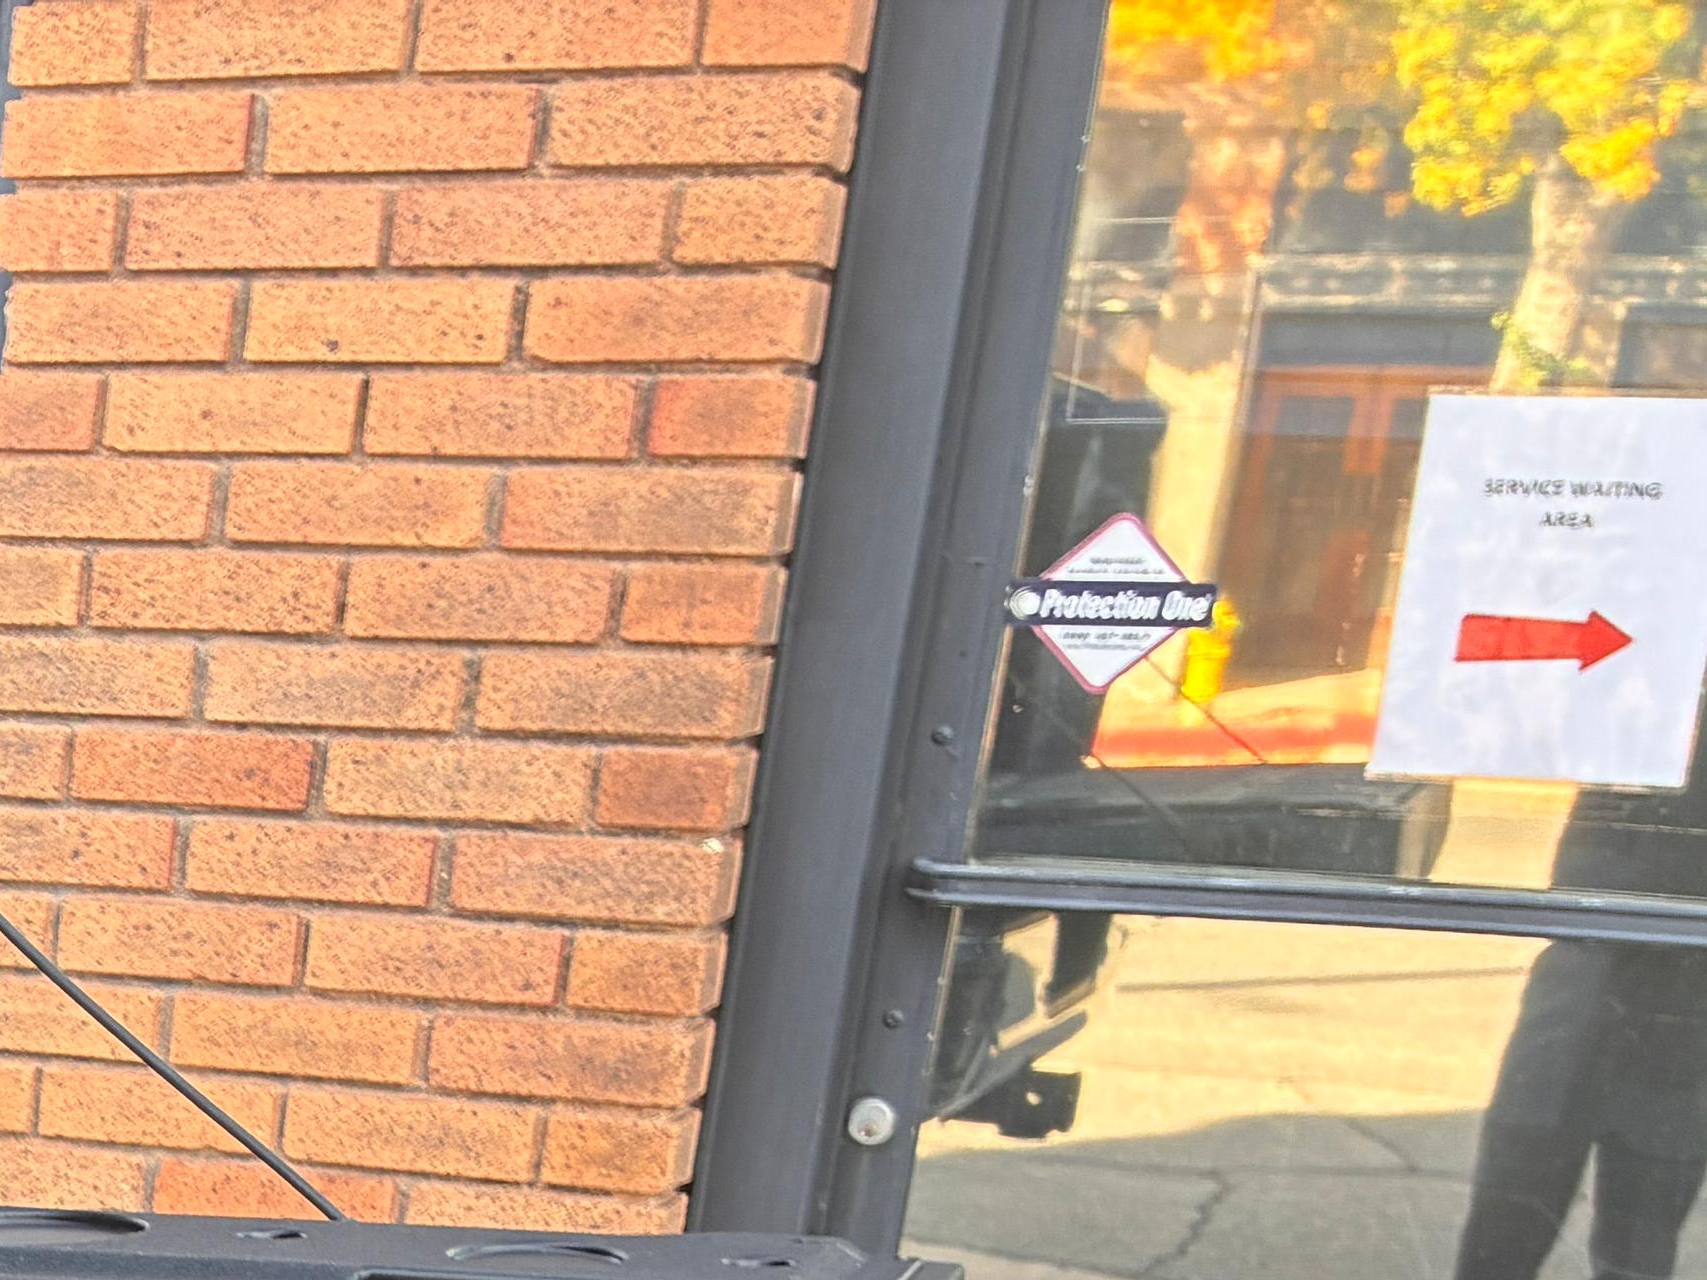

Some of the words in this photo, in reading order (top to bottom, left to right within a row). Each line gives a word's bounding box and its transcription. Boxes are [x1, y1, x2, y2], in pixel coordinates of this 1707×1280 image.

[1484, 477, 1565, 497] SERVICE
[1570, 479, 1664, 500] WAITING
[1539, 511, 1595, 528] AREA
[1039, 588, 1161, 620] Protection
[1161, 590, 1210, 622] One
